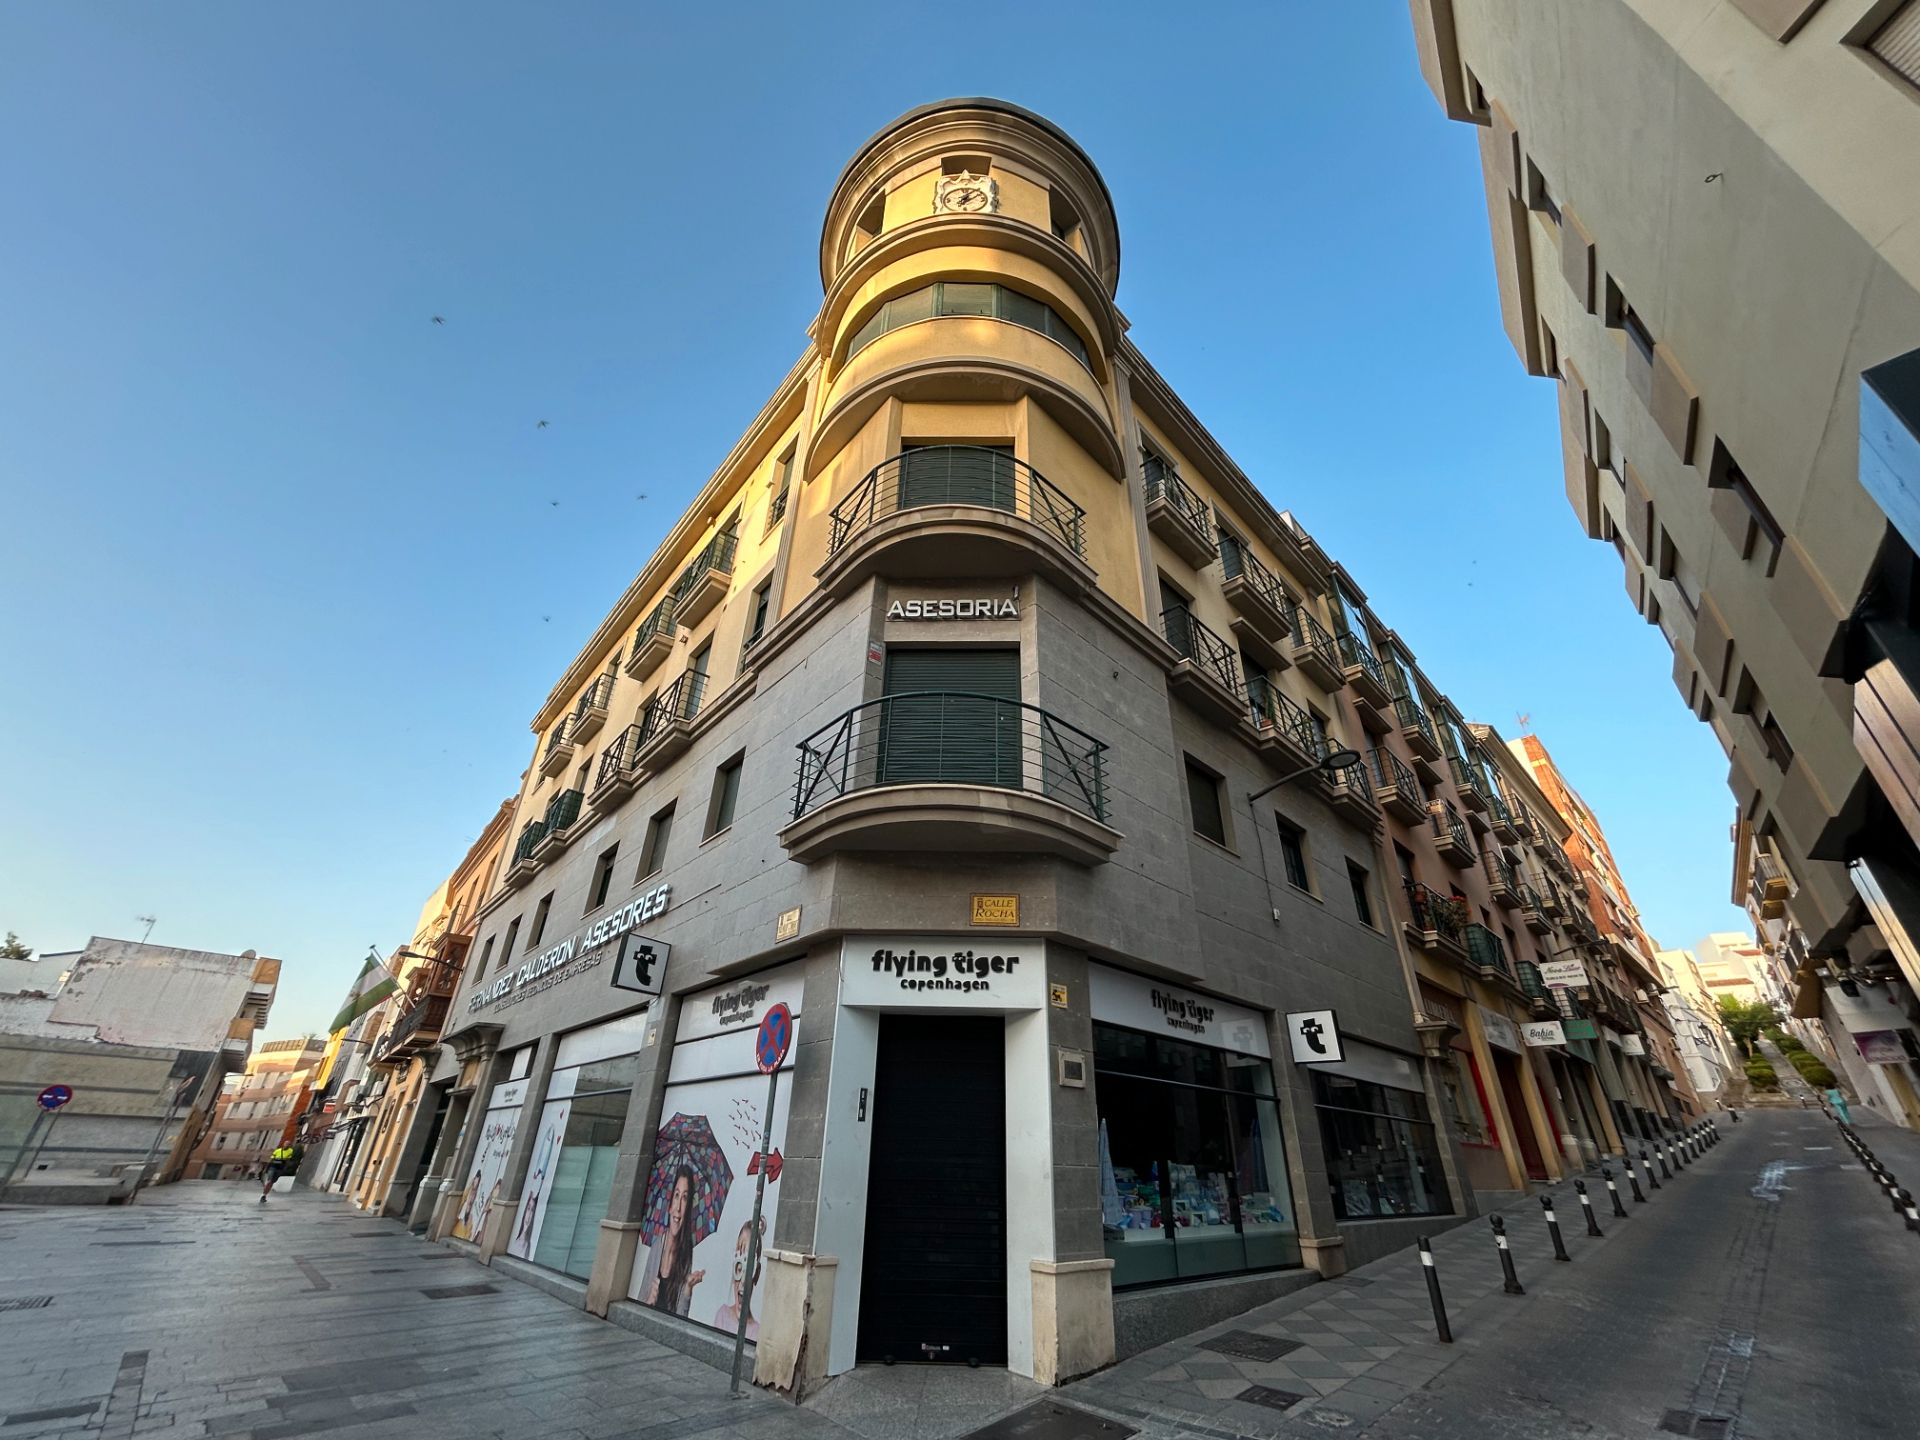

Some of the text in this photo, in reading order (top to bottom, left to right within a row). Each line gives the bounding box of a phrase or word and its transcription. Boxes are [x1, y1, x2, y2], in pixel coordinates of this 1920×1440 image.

[886, 599, 1018, 617] ASESORIA
[984, 899, 1014, 908] CALLE
[975, 908, 1015, 918] ROCHA
[515, 935, 577, 988] CALDERON
[580, 883, 671, 954] ASESORES
[871, 948, 1020, 979] flying tiger
[900, 977, 990, 993] copenhagen
[1151, 988, 1214, 1023] flying tiger
